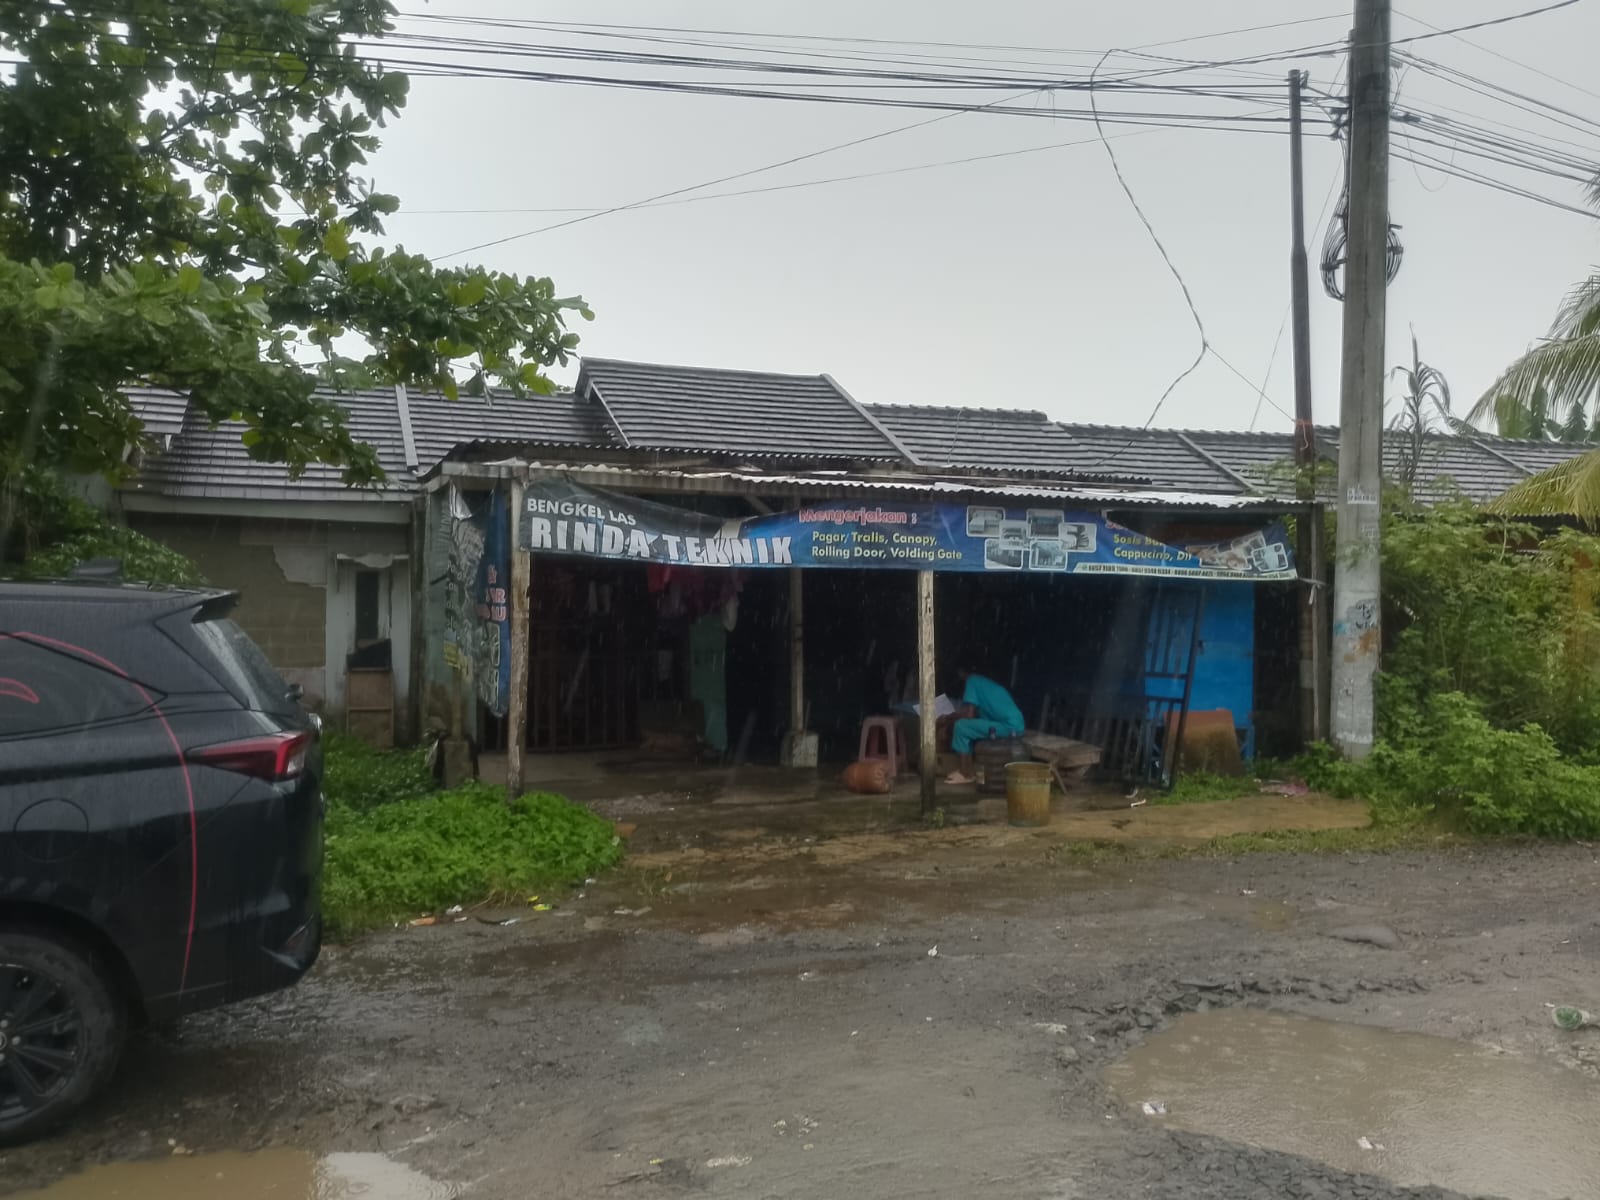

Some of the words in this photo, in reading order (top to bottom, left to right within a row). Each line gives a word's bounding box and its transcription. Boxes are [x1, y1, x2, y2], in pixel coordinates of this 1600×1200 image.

[527, 498, 605, 520] BENGKEL
[609, 510, 637, 526] LAS
[799, 508, 908, 525] Mengerjakan
[531, 517, 651, 558] RINDA
[661, 534, 793, 564] TEKNIK
[851, 531, 889, 545] Tralis,
[892, 532, 938, 546] Canopy,
[811, 545, 850, 559] Rolling
[853, 547, 887, 559] Door,
[890, 549, 935, 561] Volding
[937, 549, 963, 560] Gate
